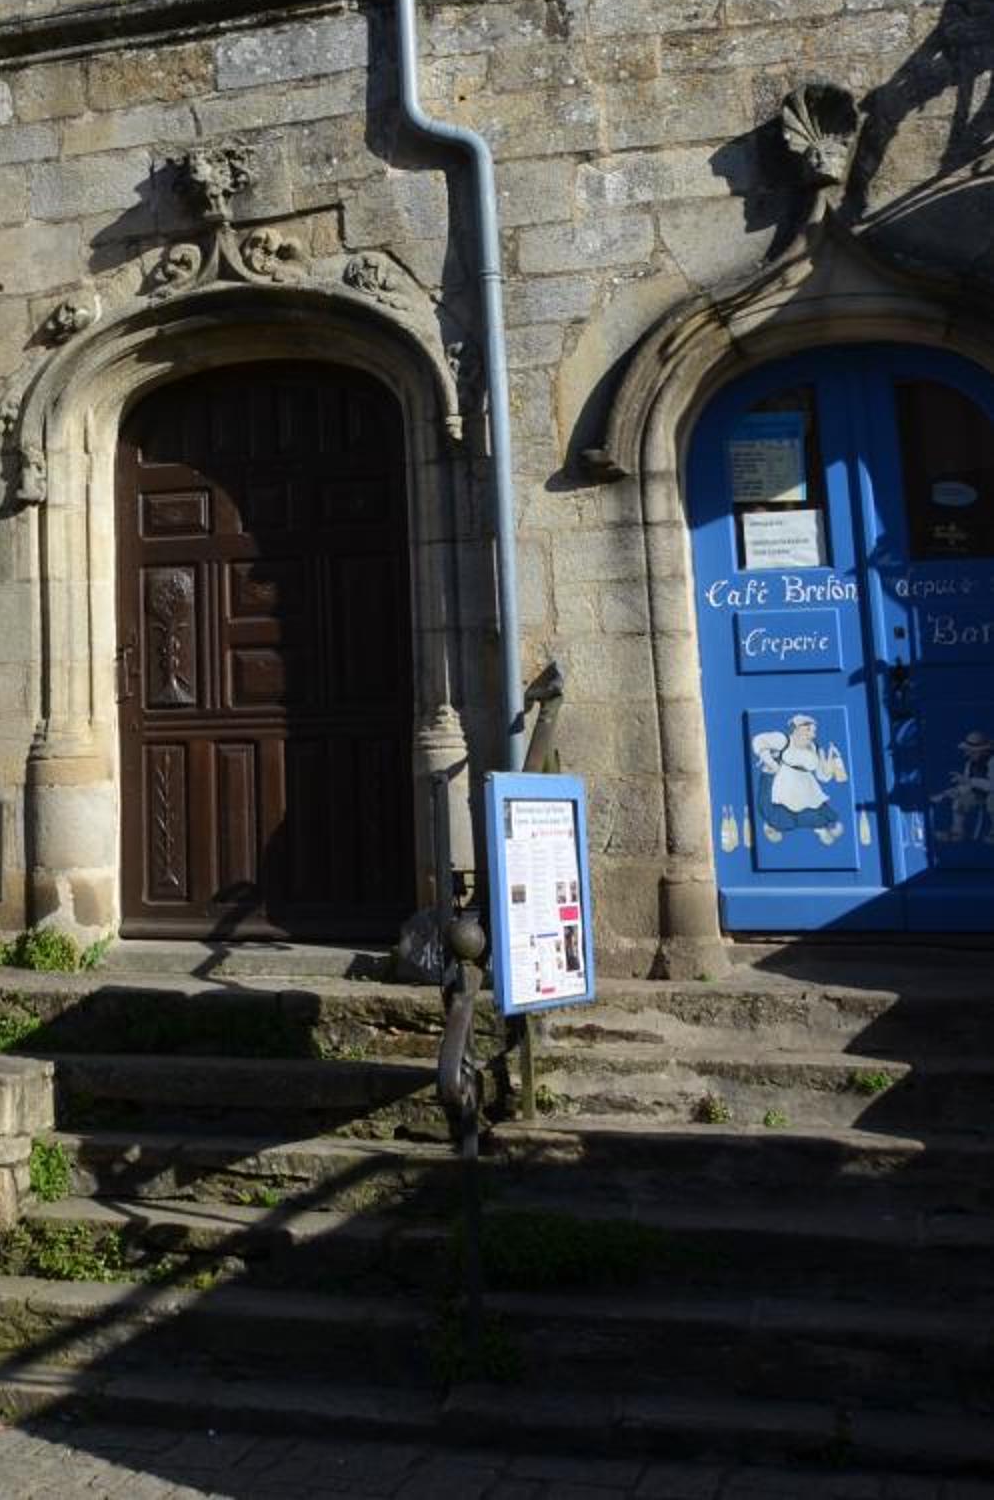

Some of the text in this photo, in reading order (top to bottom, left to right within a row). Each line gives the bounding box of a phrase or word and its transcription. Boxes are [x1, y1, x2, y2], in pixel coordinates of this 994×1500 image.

[705, 573, 858, 607] Café Breton
[742, 627, 829, 660] Creperie
